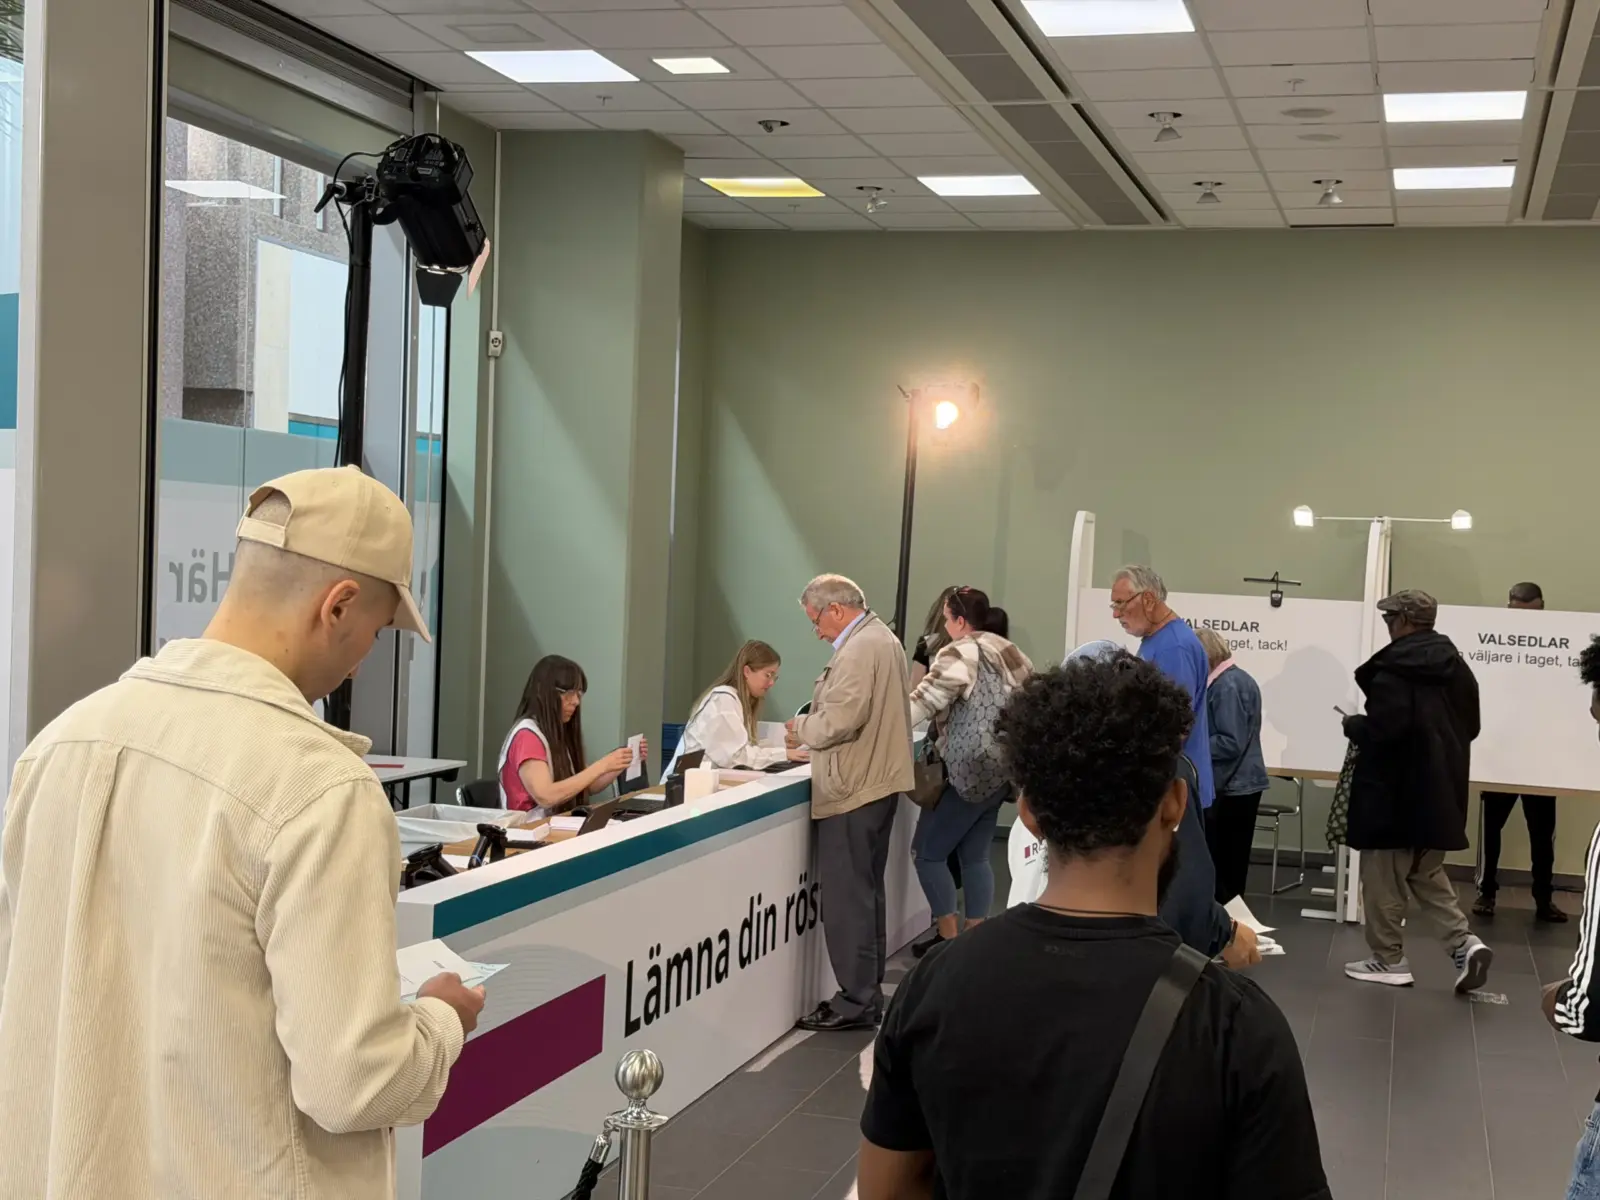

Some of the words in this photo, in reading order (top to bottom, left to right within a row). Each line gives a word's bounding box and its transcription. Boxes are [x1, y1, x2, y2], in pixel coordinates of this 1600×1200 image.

[1183, 618, 1260, 632] ALSEDLAR
[1258, 639, 1288, 651] tack!
[1478, 633, 1570, 649] VALSEDLAR
[1468, 649, 1513, 664] väljare
[1525, 653, 1563, 668] taget,
[624, 928, 730, 1038] Lämna
[738, 892, 777, 970] din
